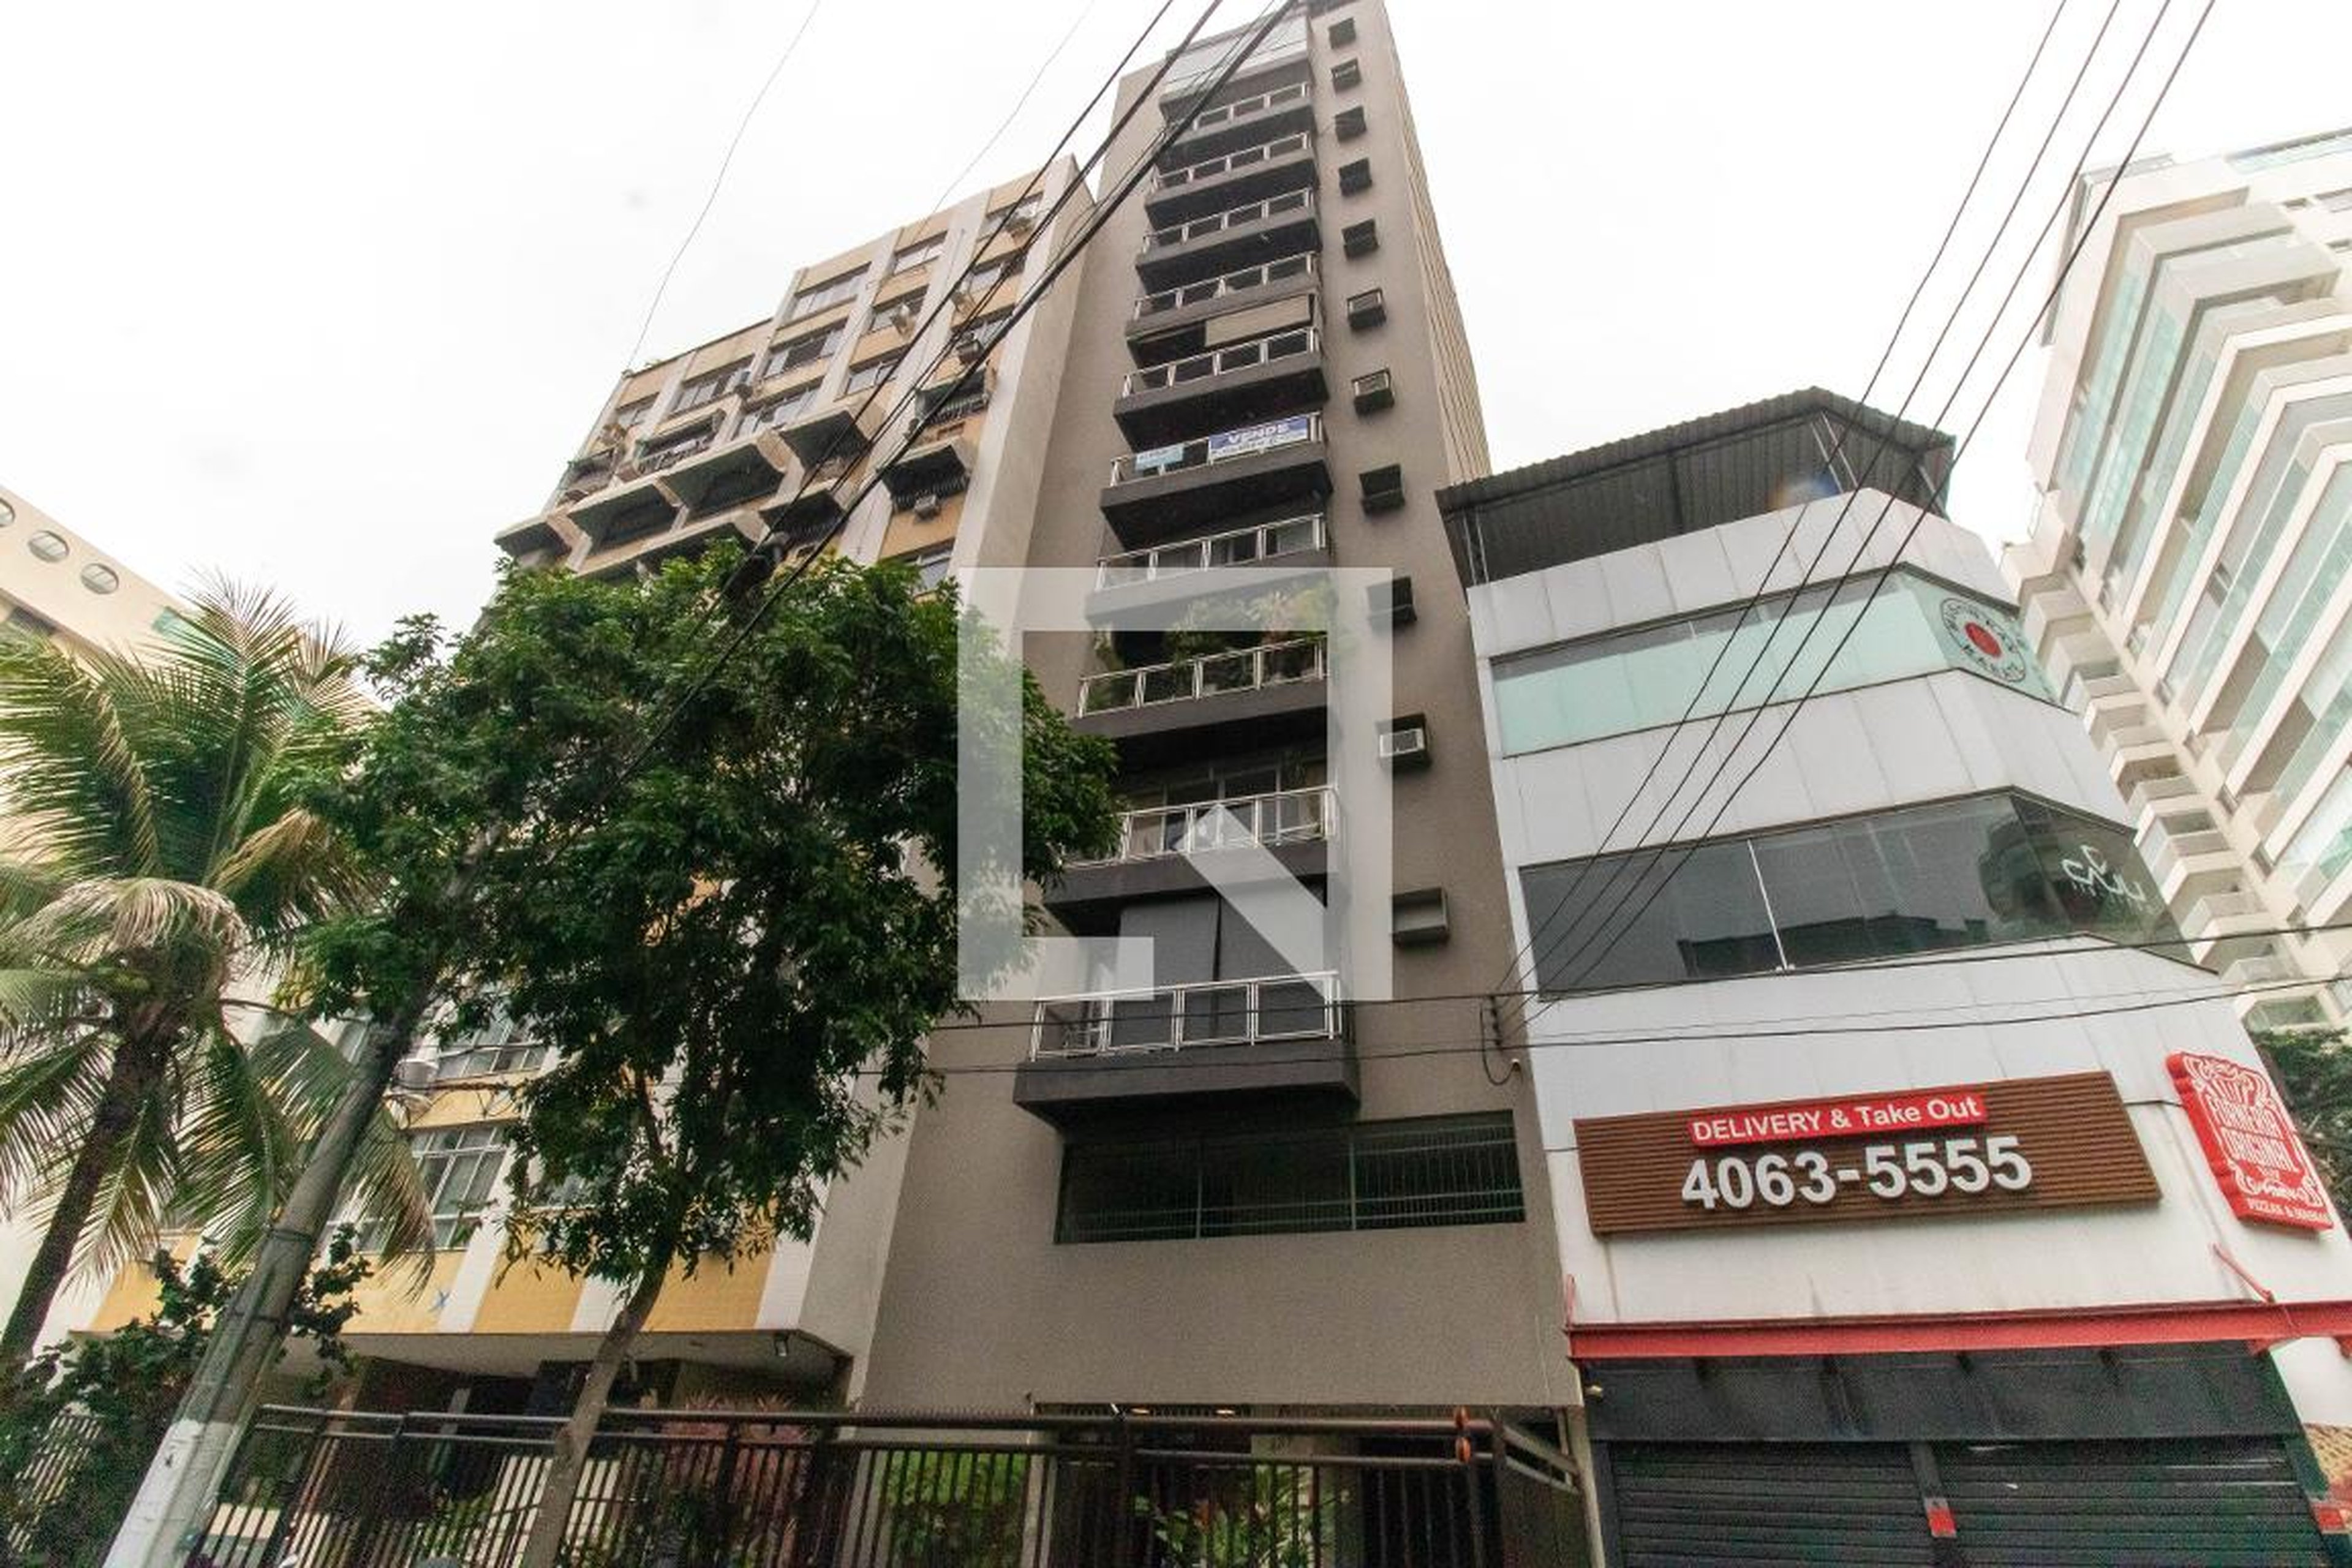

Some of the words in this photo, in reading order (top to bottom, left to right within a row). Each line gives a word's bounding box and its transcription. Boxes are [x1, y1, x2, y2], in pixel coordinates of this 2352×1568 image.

[1692, 1110, 1822, 1140] DELIVERY
[1830, 1108, 1852, 1128] &
[1853, 1101, 1922, 1128] Take
[1927, 1096, 1981, 1120] Out
[1681, 1135, 2033, 1209] 4063-5555
